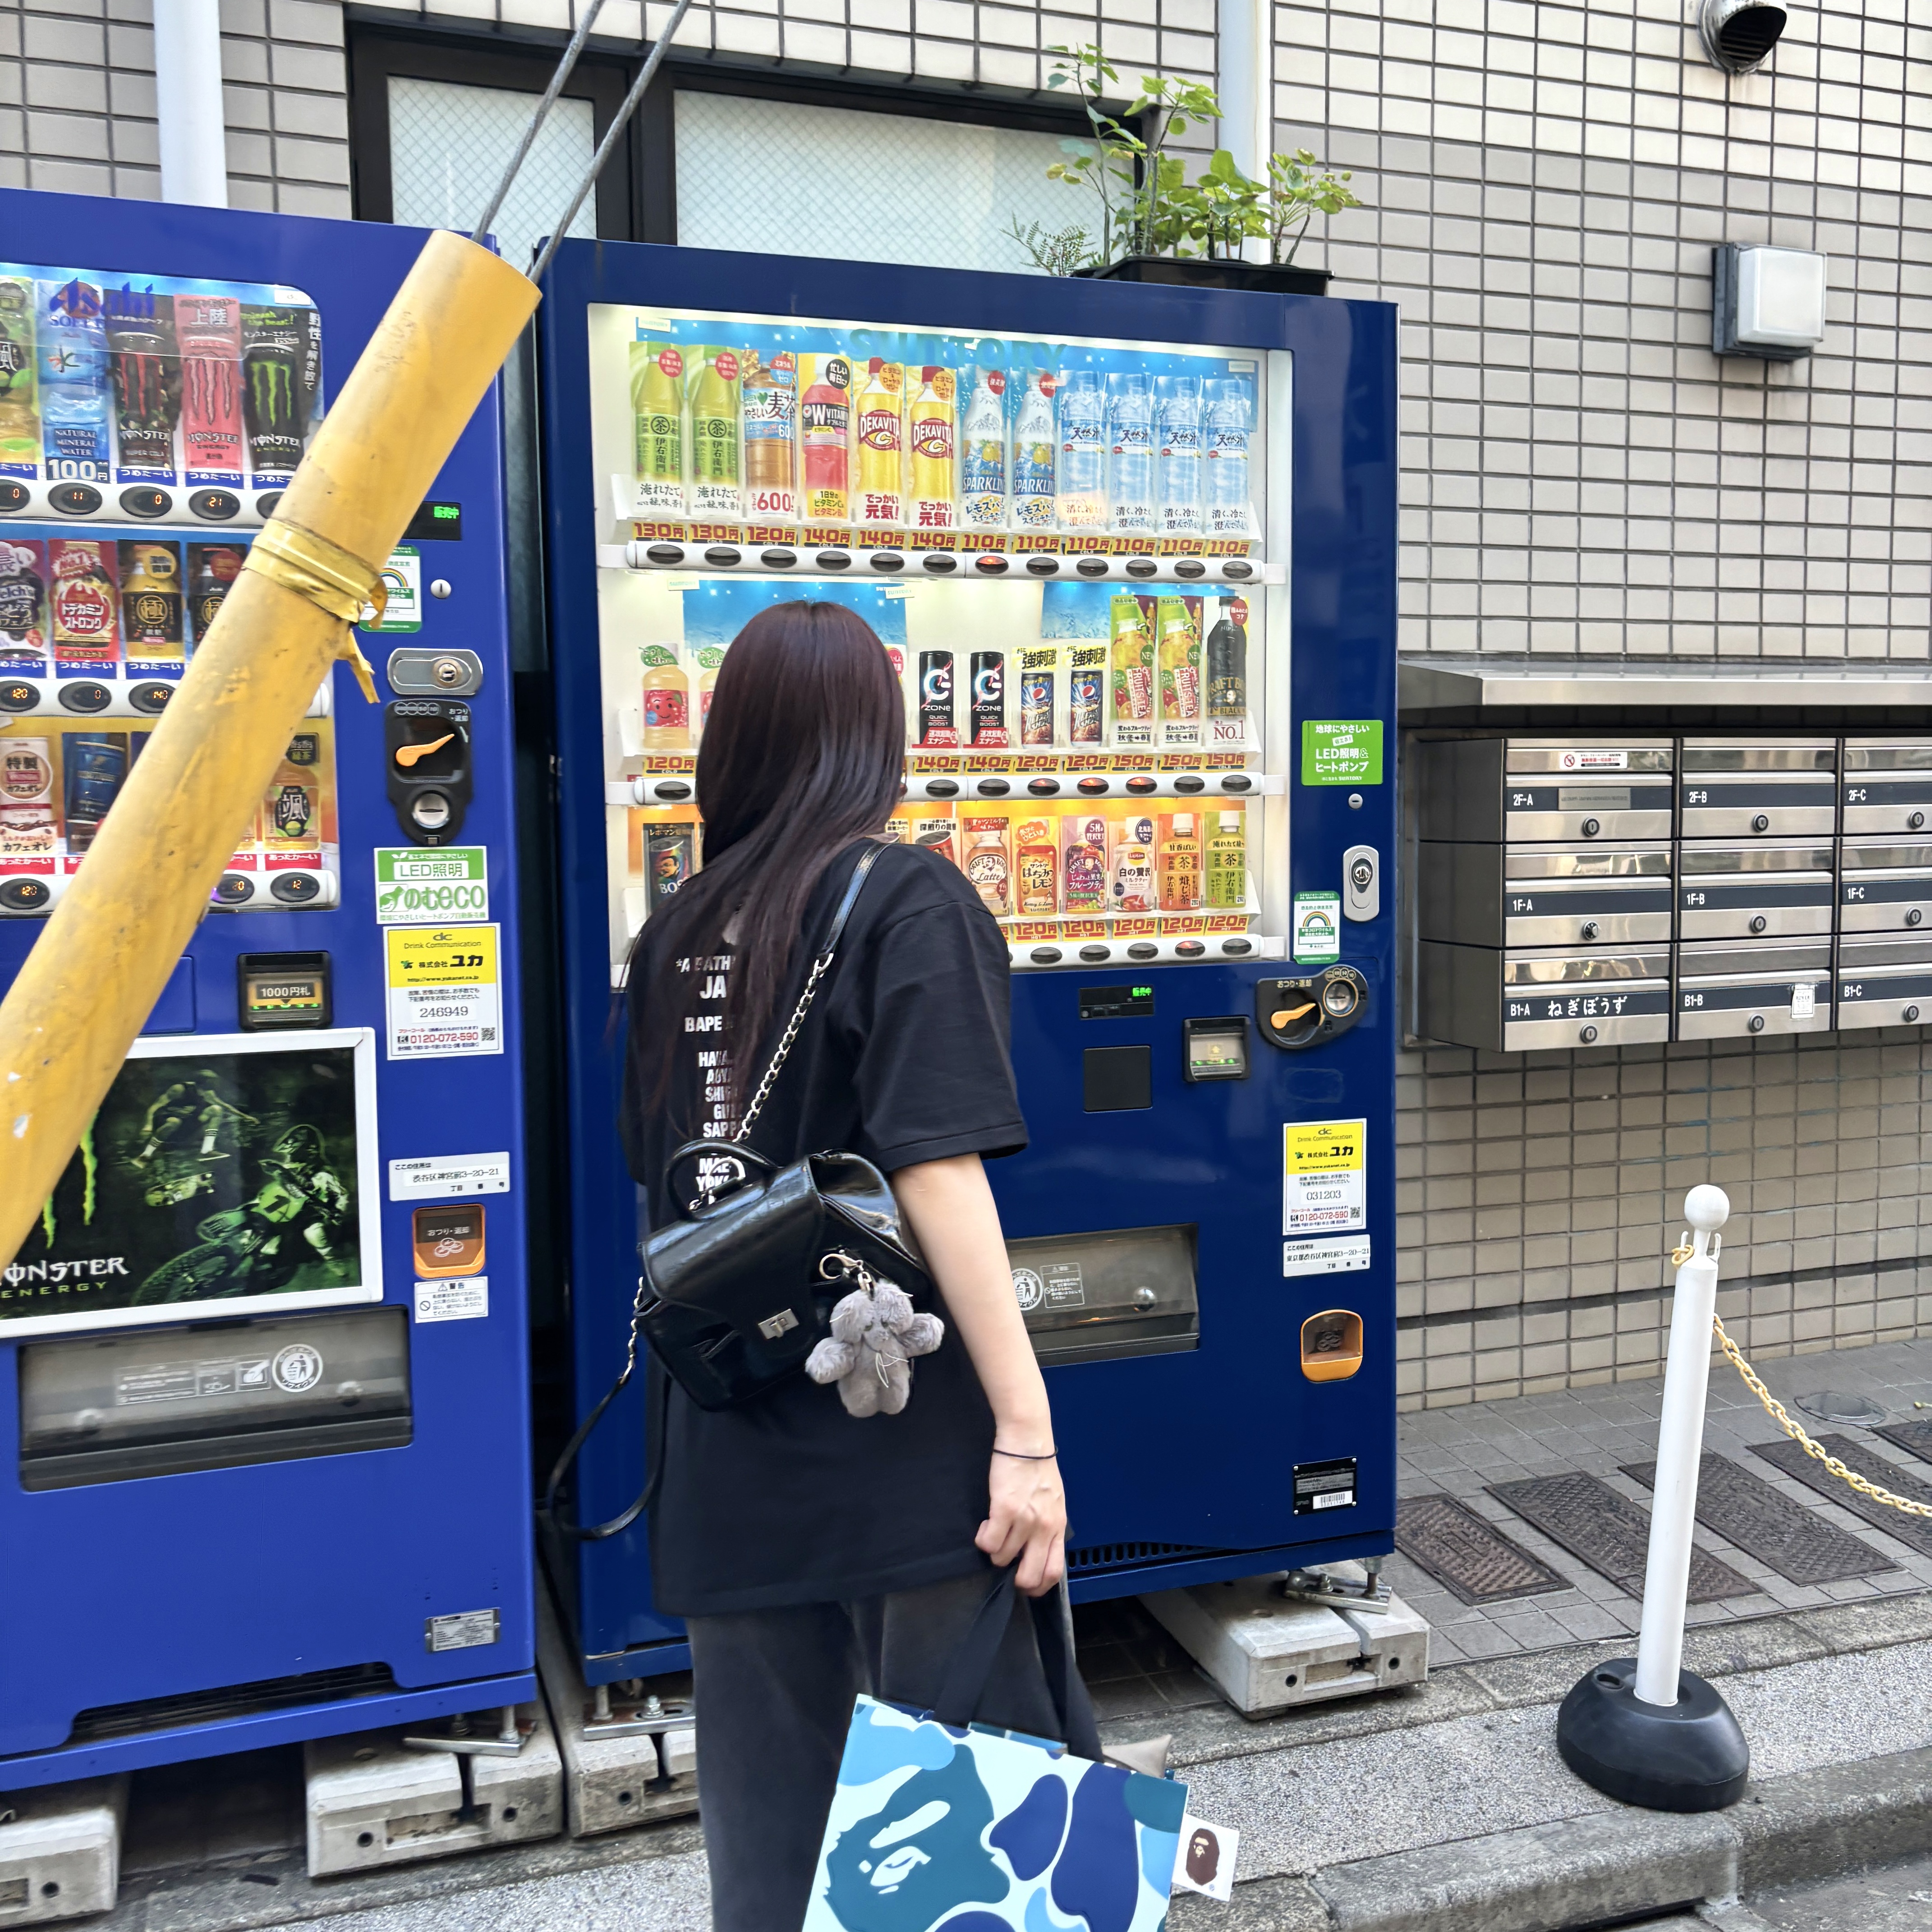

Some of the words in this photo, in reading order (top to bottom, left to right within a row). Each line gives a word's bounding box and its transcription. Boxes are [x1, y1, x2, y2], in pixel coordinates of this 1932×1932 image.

[191, 308, 228, 326] 上陸
[812, 404, 826, 426] W
[654, 419, 667, 432] 茶
[711, 423, 724, 435] 茶
[860, 414, 900, 438] DEKAVITA
[913, 423, 953, 446] DEKAVITA
[56, 439, 97, 447] MINERAL
[656, 437, 667, 473] 伊右衛門
[712, 441, 723, 476] 伊右衛門
[963, 476, 1005, 492] SPARKLIN
[1014, 478, 1055, 493] SPARKLIN
[865, 494, 898, 504] でっかい
[919, 501, 952, 511] でっかい
[634, 523, 684, 538] 130円
[690, 524, 739, 539] 130円
[747, 525, 795, 542] 120円
[805, 528, 850, 543] 140円
[860, 530, 905, 545] 140円
[912, 532, 957, 547] 140円
[964, 534, 1006, 548] 110円
[1018, 536, 1060, 549] 110円
[1069, 537, 1110, 550] 110円
[1115, 538, 1155, 552] 110円
[1164, 539, 1203, 552] 110円
[1211, 541, 1249, 553] 110円
[1210, 677, 1234, 695] RAFT
[1214, 720, 1246, 740] NO.1
[1316, 724, 1370, 734] 地球にやさしい
[1114, 754, 1154, 766] 150円
[1164, 754, 1202, 766] 150円
[1207, 753, 1245, 765] 150円
[1316, 748, 1369, 759] LED照明&
[646, 756, 694, 769] 120円
[916, 756, 960, 768] 140円
[968, 756, 1010, 768] 140円
[1017, 755, 1058, 767] 120円
[1066, 755, 1109, 766] 120円
[1316, 761, 1369, 773] ヒートポンプ
[1513, 793, 1534, 806] 2F-A
[1689, 791, 1707, 803] 2F-B
[1849, 789, 1867, 801] 2F-C
[3, 842, 52, 852] カフェオレ
[1178, 856, 1190, 869] 茶
[1224, 854, 1237, 866] 茶
[400, 863, 463, 877] LED照明
[1022, 867, 1053, 878] はちみつ
[977, 873, 1003, 881] Latte
[1032, 878, 1053, 889] レモン
[1179, 875, 1190, 905] 焙じ茶
[1225, 871, 1235, 903] 伊右衛門
[1847, 887, 1865, 900] 1F-C
[1513, 899, 1533, 912] 1F-A
[1686, 893, 1705, 906] 1F-B
[1063, 920, 1104, 933] 120円
[1114, 919, 1155, 932] 120円
[1162, 917, 1204, 929] 120円
[1210, 915, 1247, 927] 120円
[1014, 922, 1058, 935] 120円
[261, 986, 311, 998] 1000円札
[1844, 985, 1863, 998] B1-C
[1510, 1003, 1530, 1017] B1-A
[1547, 995, 1628, 1017] ねぎぼうず
[1684, 995, 1703, 1007] B1-B
[419, 1006, 469, 1018] 246949
[685, 1016, 722, 1033] BAPE
[410, 1032, 478, 1044] 0120-072-590
[1306, 1190, 1342, 1201] 031203
[1300, 1210, 1348, 1222] 0120-072-590
[2, 1256, 130, 1287] ONSTER
[0, 1281, 107, 1299] ENERGY
